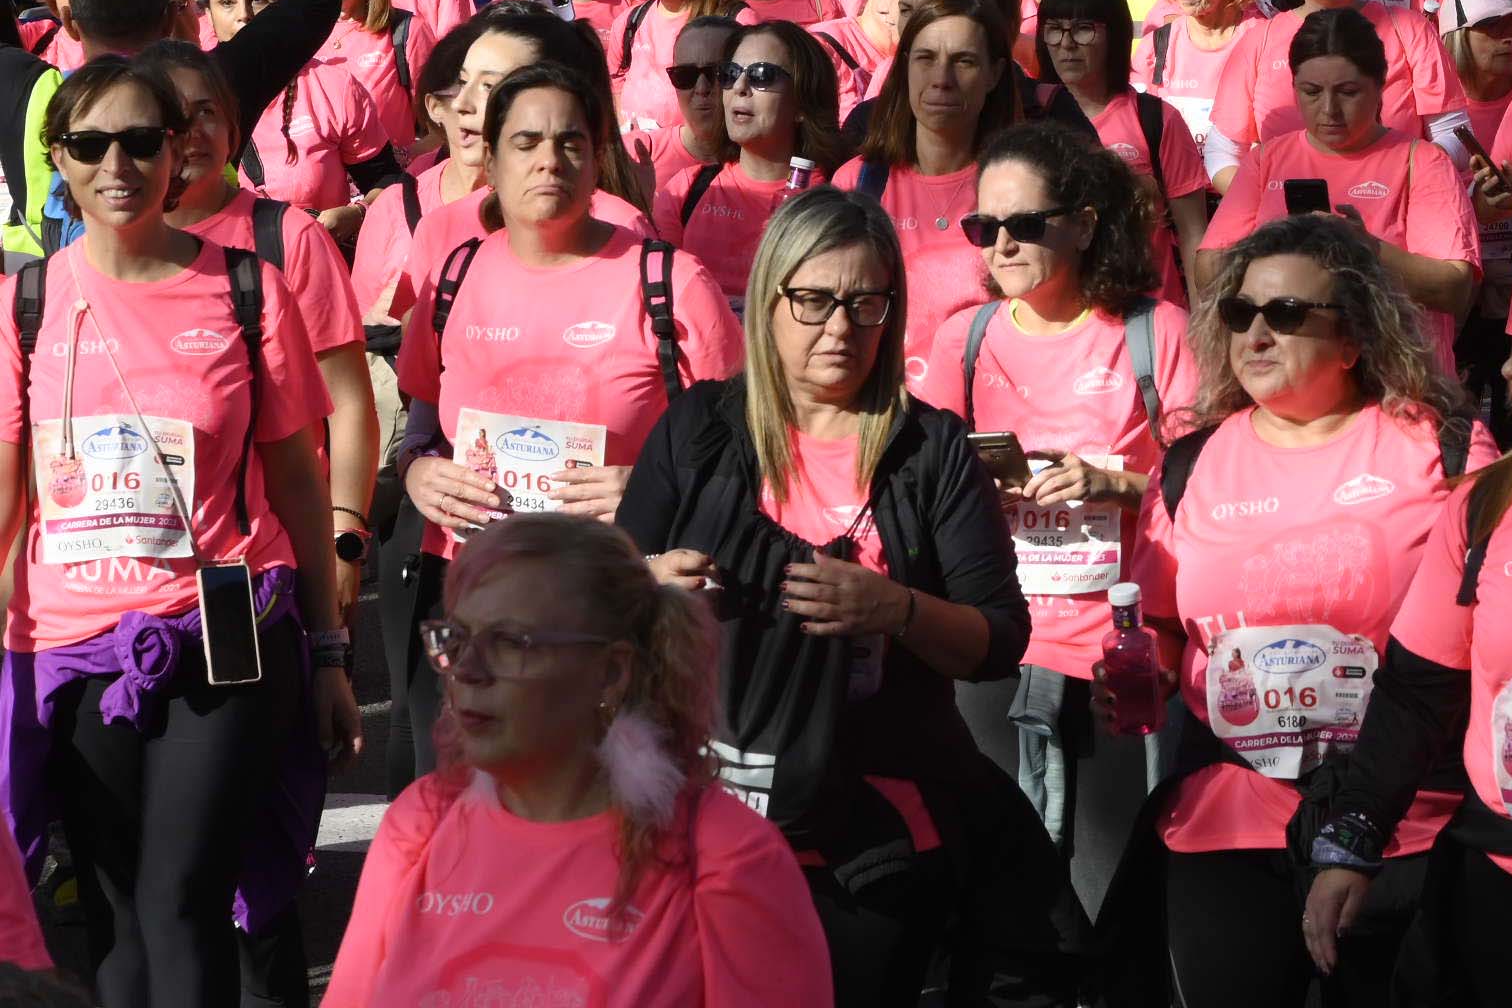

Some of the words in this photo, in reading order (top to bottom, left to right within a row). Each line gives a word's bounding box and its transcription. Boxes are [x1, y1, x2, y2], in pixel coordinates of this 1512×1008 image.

[466, 325, 520, 341] OYSHO
[53, 338, 120, 357] OSHO
[154, 436, 184, 446] SUMA
[501, 437, 555, 457] ASTURIANA
[565, 441, 593, 452] SUMA
[92, 472, 141, 492] 016
[503, 470, 550, 492] 016
[96, 497, 135, 511] 29436
[507, 495, 545, 511] 29434
[1211, 496, 1280, 521] OYSHO
[61, 518, 98, 530] CARRERA
[100, 517, 112, 526] DE
[125, 516, 155, 524] MUJER
[1023, 510, 1070, 529] 016
[1062, 572, 1109, 583] Santander
[1332, 646, 1365, 655] SUMA
[1262, 653, 1320, 667] ASTURIANA
[1263, 687, 1318, 710] 016
[1235, 736, 1278, 748] CARRERA
[1291, 736, 1303, 744] LA
[416, 891, 495, 916] OYSHO
